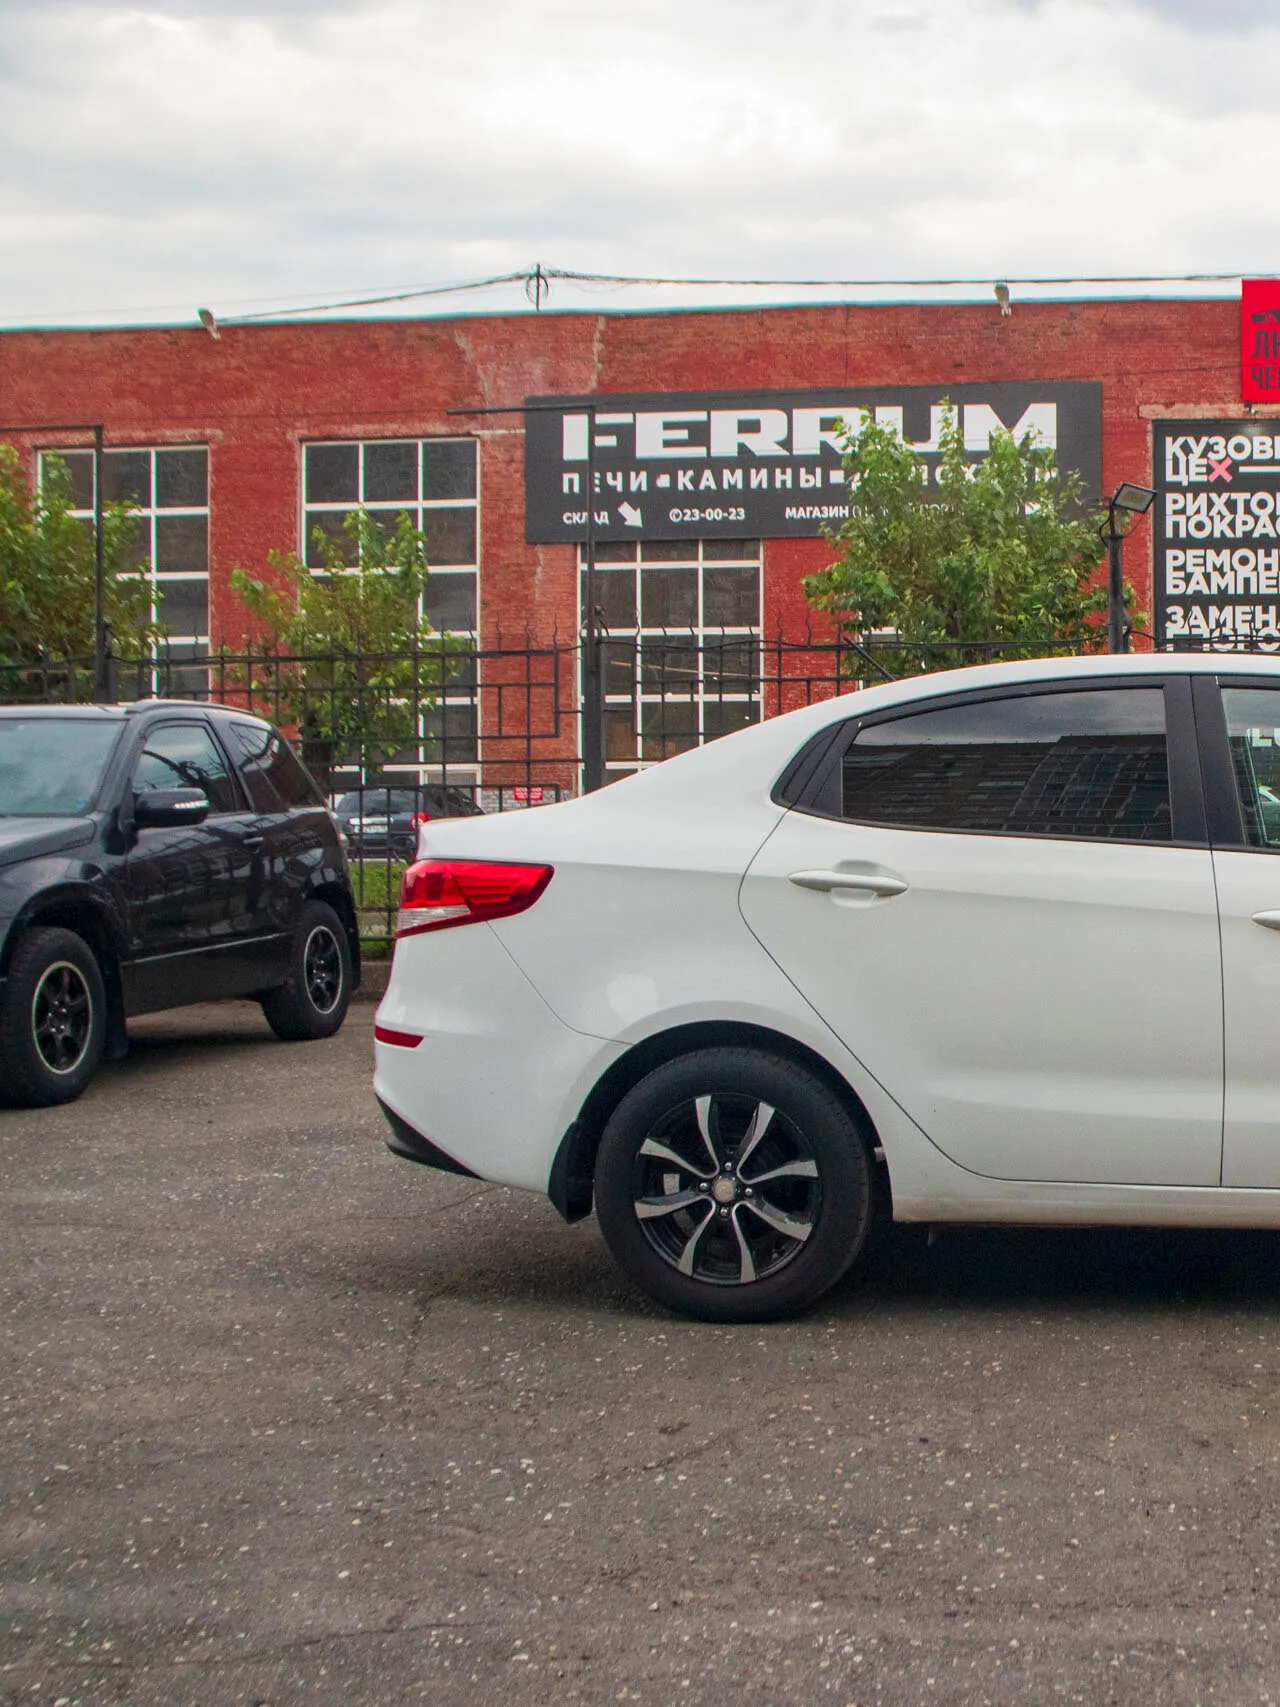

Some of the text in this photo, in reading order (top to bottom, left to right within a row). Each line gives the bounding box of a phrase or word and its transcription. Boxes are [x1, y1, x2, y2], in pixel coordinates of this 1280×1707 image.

[562, 402, 1058, 461] FERRUM
[677, 466, 822, 491] КАМИНЫ
[1165, 457, 1233, 486] ЦЕХ
[785, 504, 849, 519] МАГАЗИН
